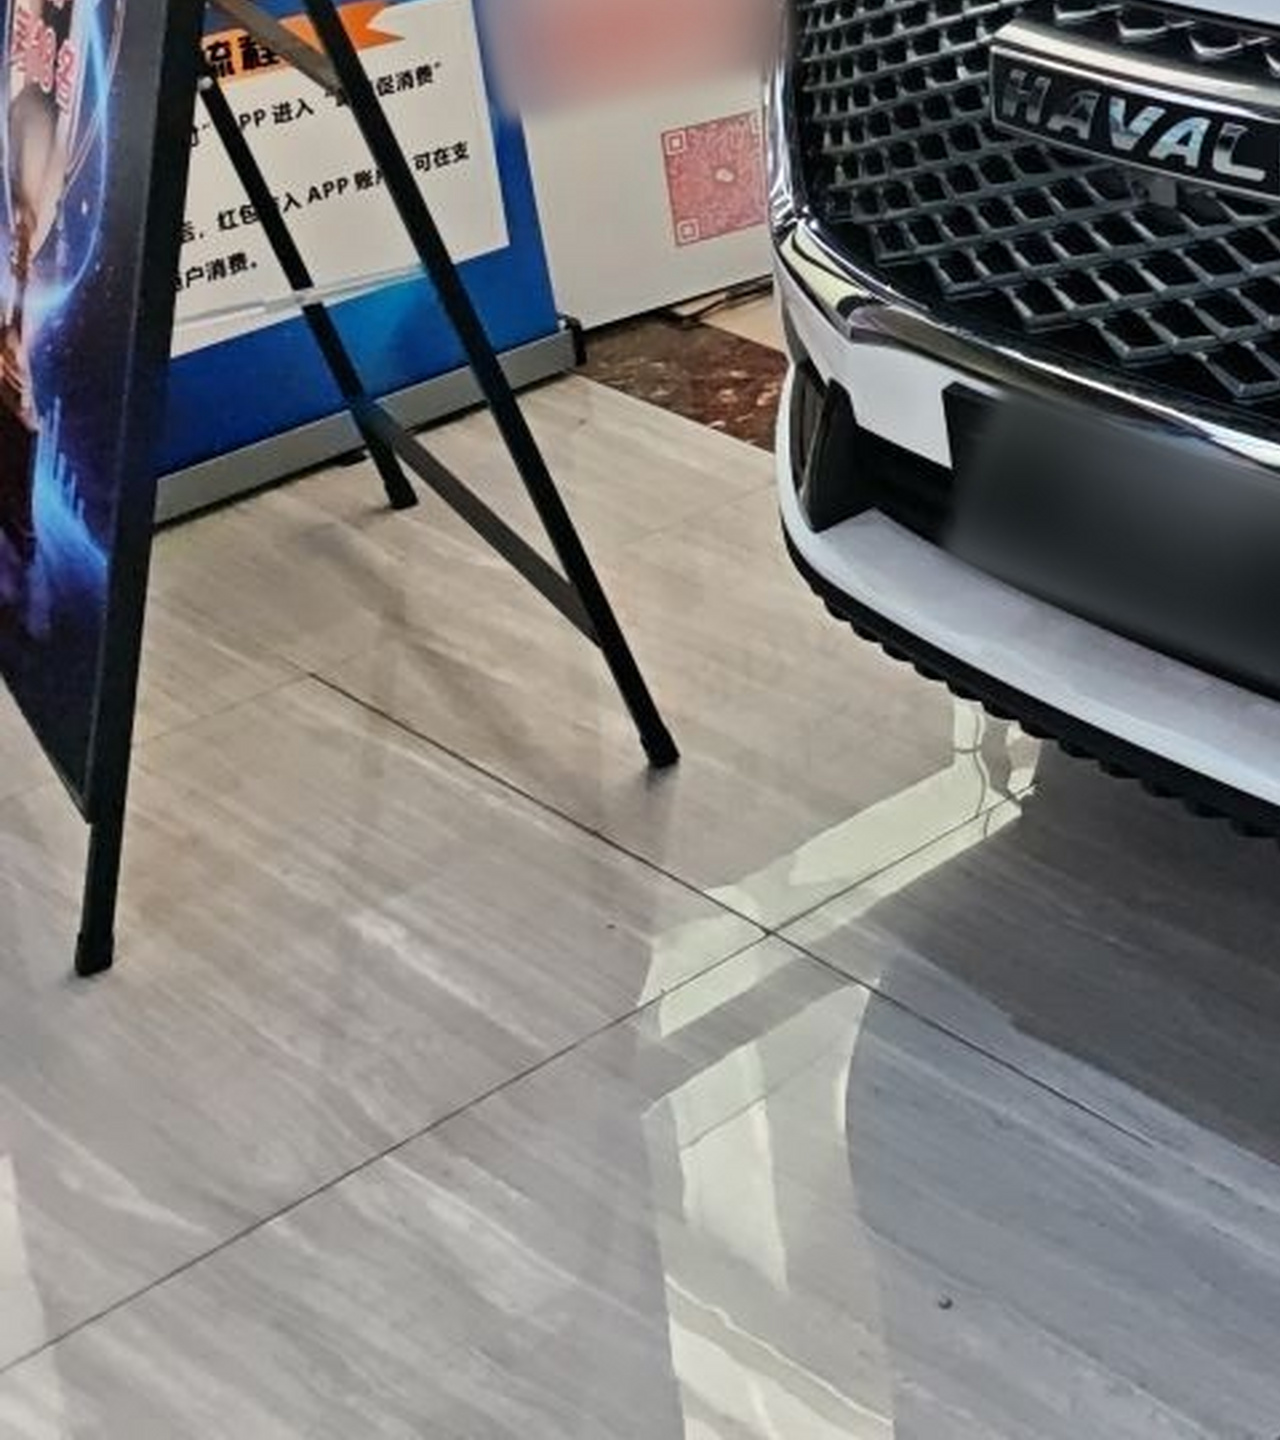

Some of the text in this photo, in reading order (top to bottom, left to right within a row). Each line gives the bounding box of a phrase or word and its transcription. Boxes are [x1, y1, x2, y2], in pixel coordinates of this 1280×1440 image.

[272, 98, 315, 124] 进入
[1001, 68, 1265, 182] HAVAL
[308, 177, 349, 204] APP
